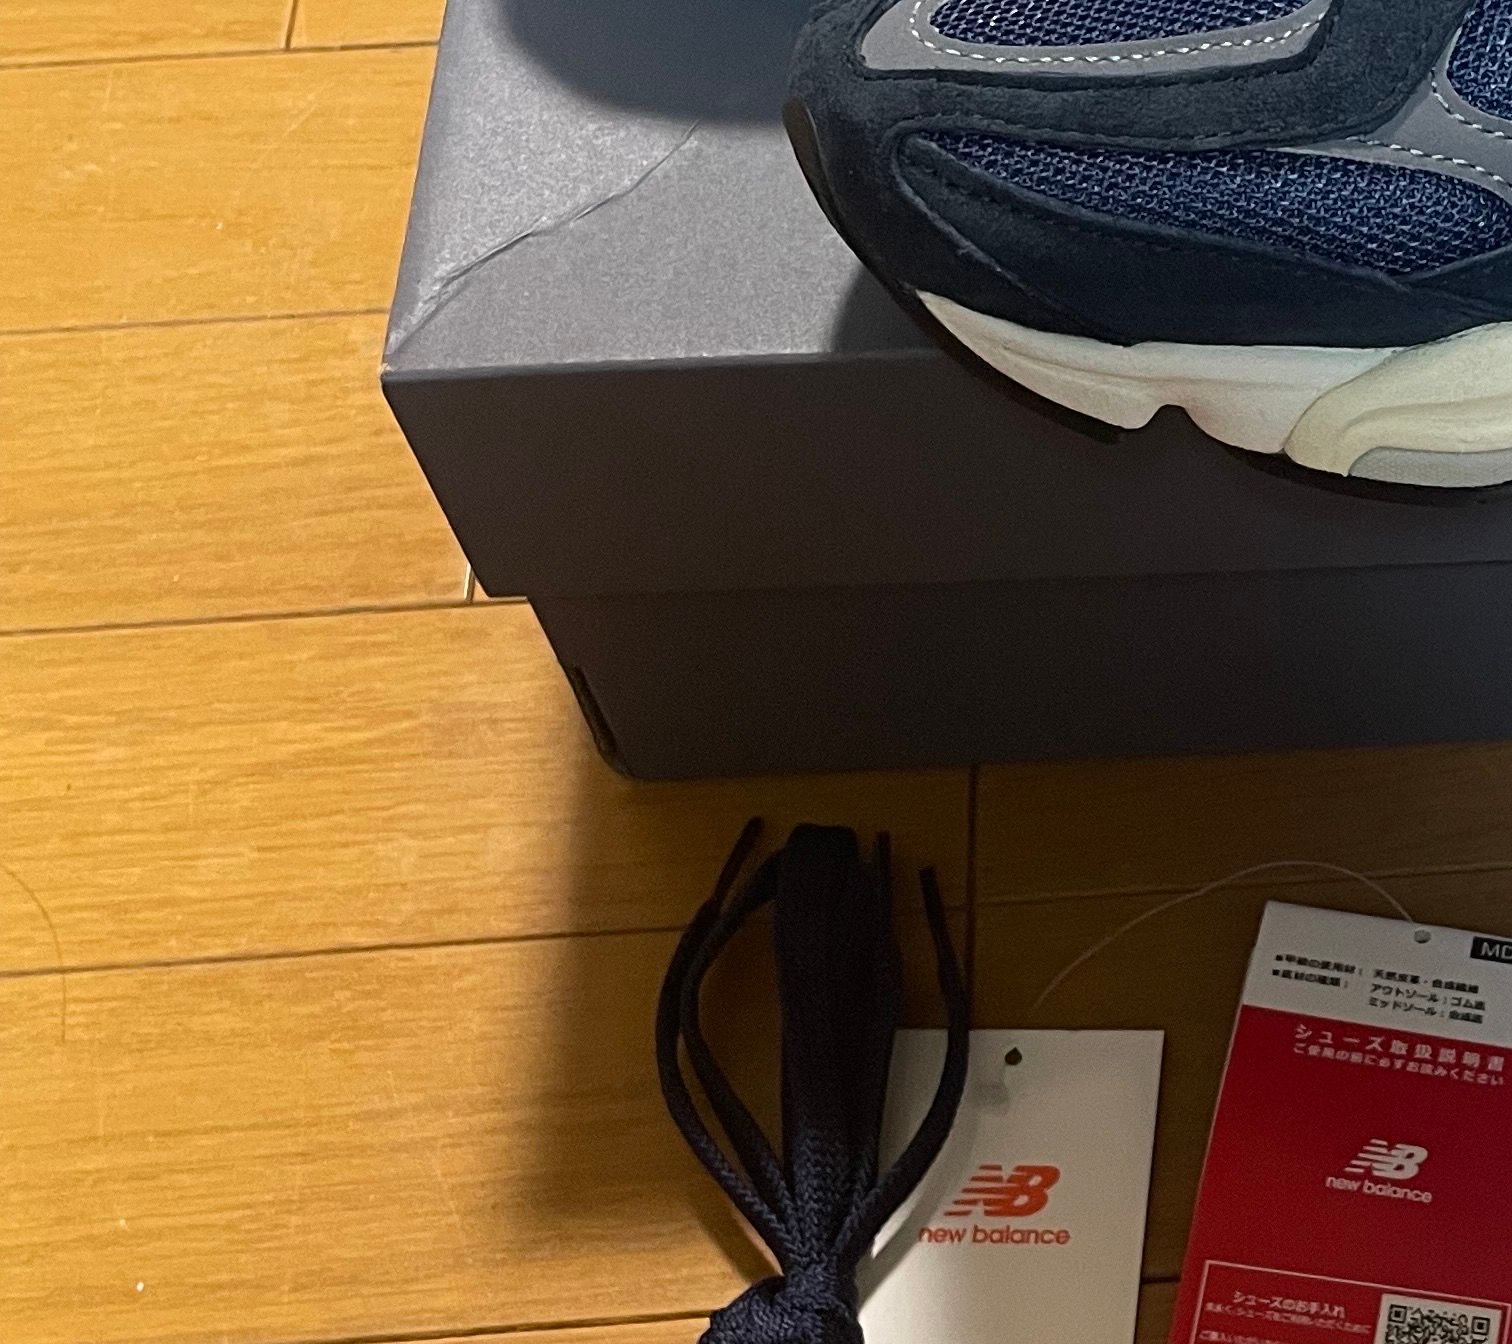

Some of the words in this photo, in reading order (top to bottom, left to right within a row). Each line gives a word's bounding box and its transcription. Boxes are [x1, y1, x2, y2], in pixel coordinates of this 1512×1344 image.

[1325, 1176, 1362, 1192] new
[1362, 1179, 1433, 1204] balance
[917, 1225, 966, 1244] new
[971, 1223, 1072, 1245] balance
